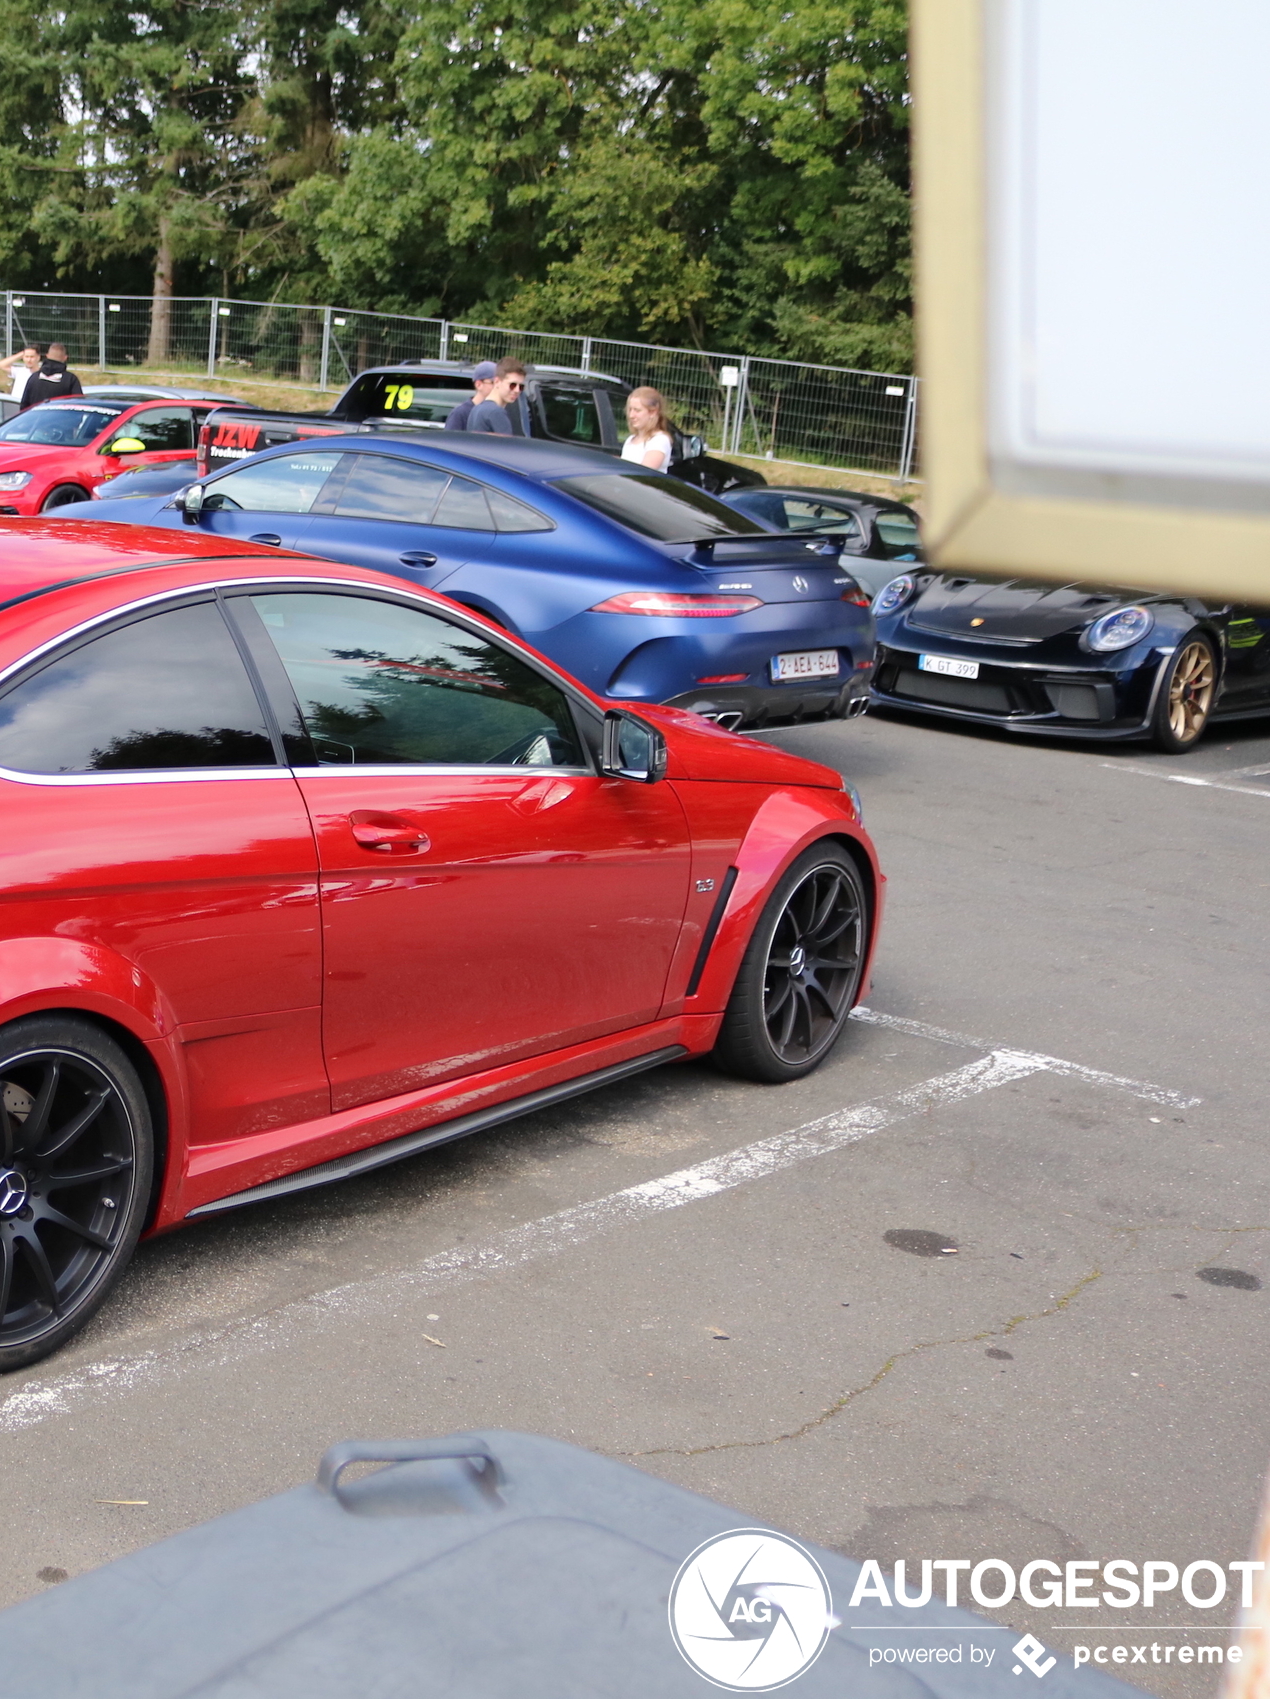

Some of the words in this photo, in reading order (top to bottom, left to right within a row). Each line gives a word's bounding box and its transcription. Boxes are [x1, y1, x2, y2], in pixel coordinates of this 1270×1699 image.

[384, 385, 414, 410] 79
[212, 422, 262, 449] JZW
[925, 659, 933, 669] K
[938, 660, 951, 673] GT
[955, 663, 976, 677] 399
